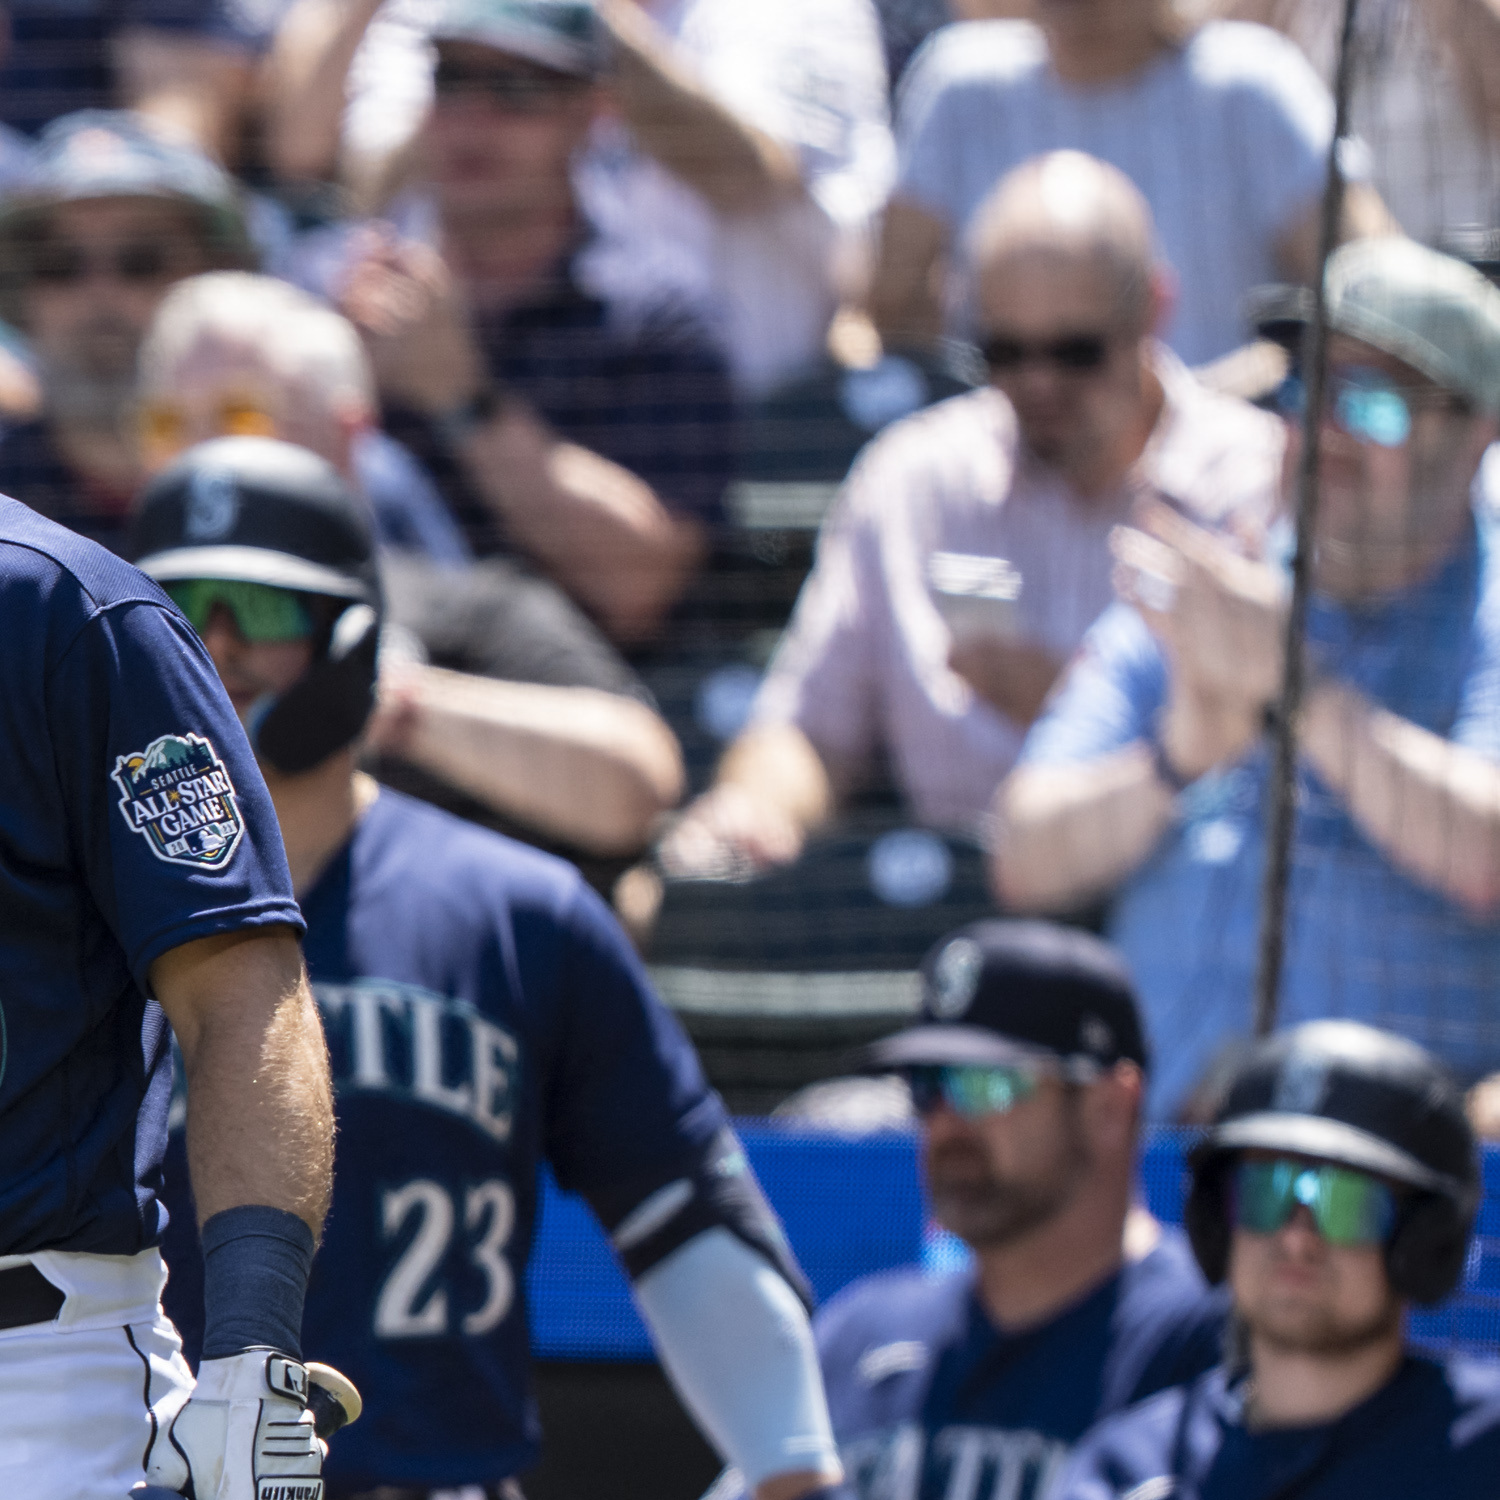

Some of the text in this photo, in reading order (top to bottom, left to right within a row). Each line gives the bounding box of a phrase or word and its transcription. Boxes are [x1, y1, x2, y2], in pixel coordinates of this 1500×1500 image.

[132, 771, 229, 824] ALL STAR
[151, 764, 198, 790] SEATTLE
[161, 797, 224, 836] GAME
[374, 1178, 516, 1340] 23
